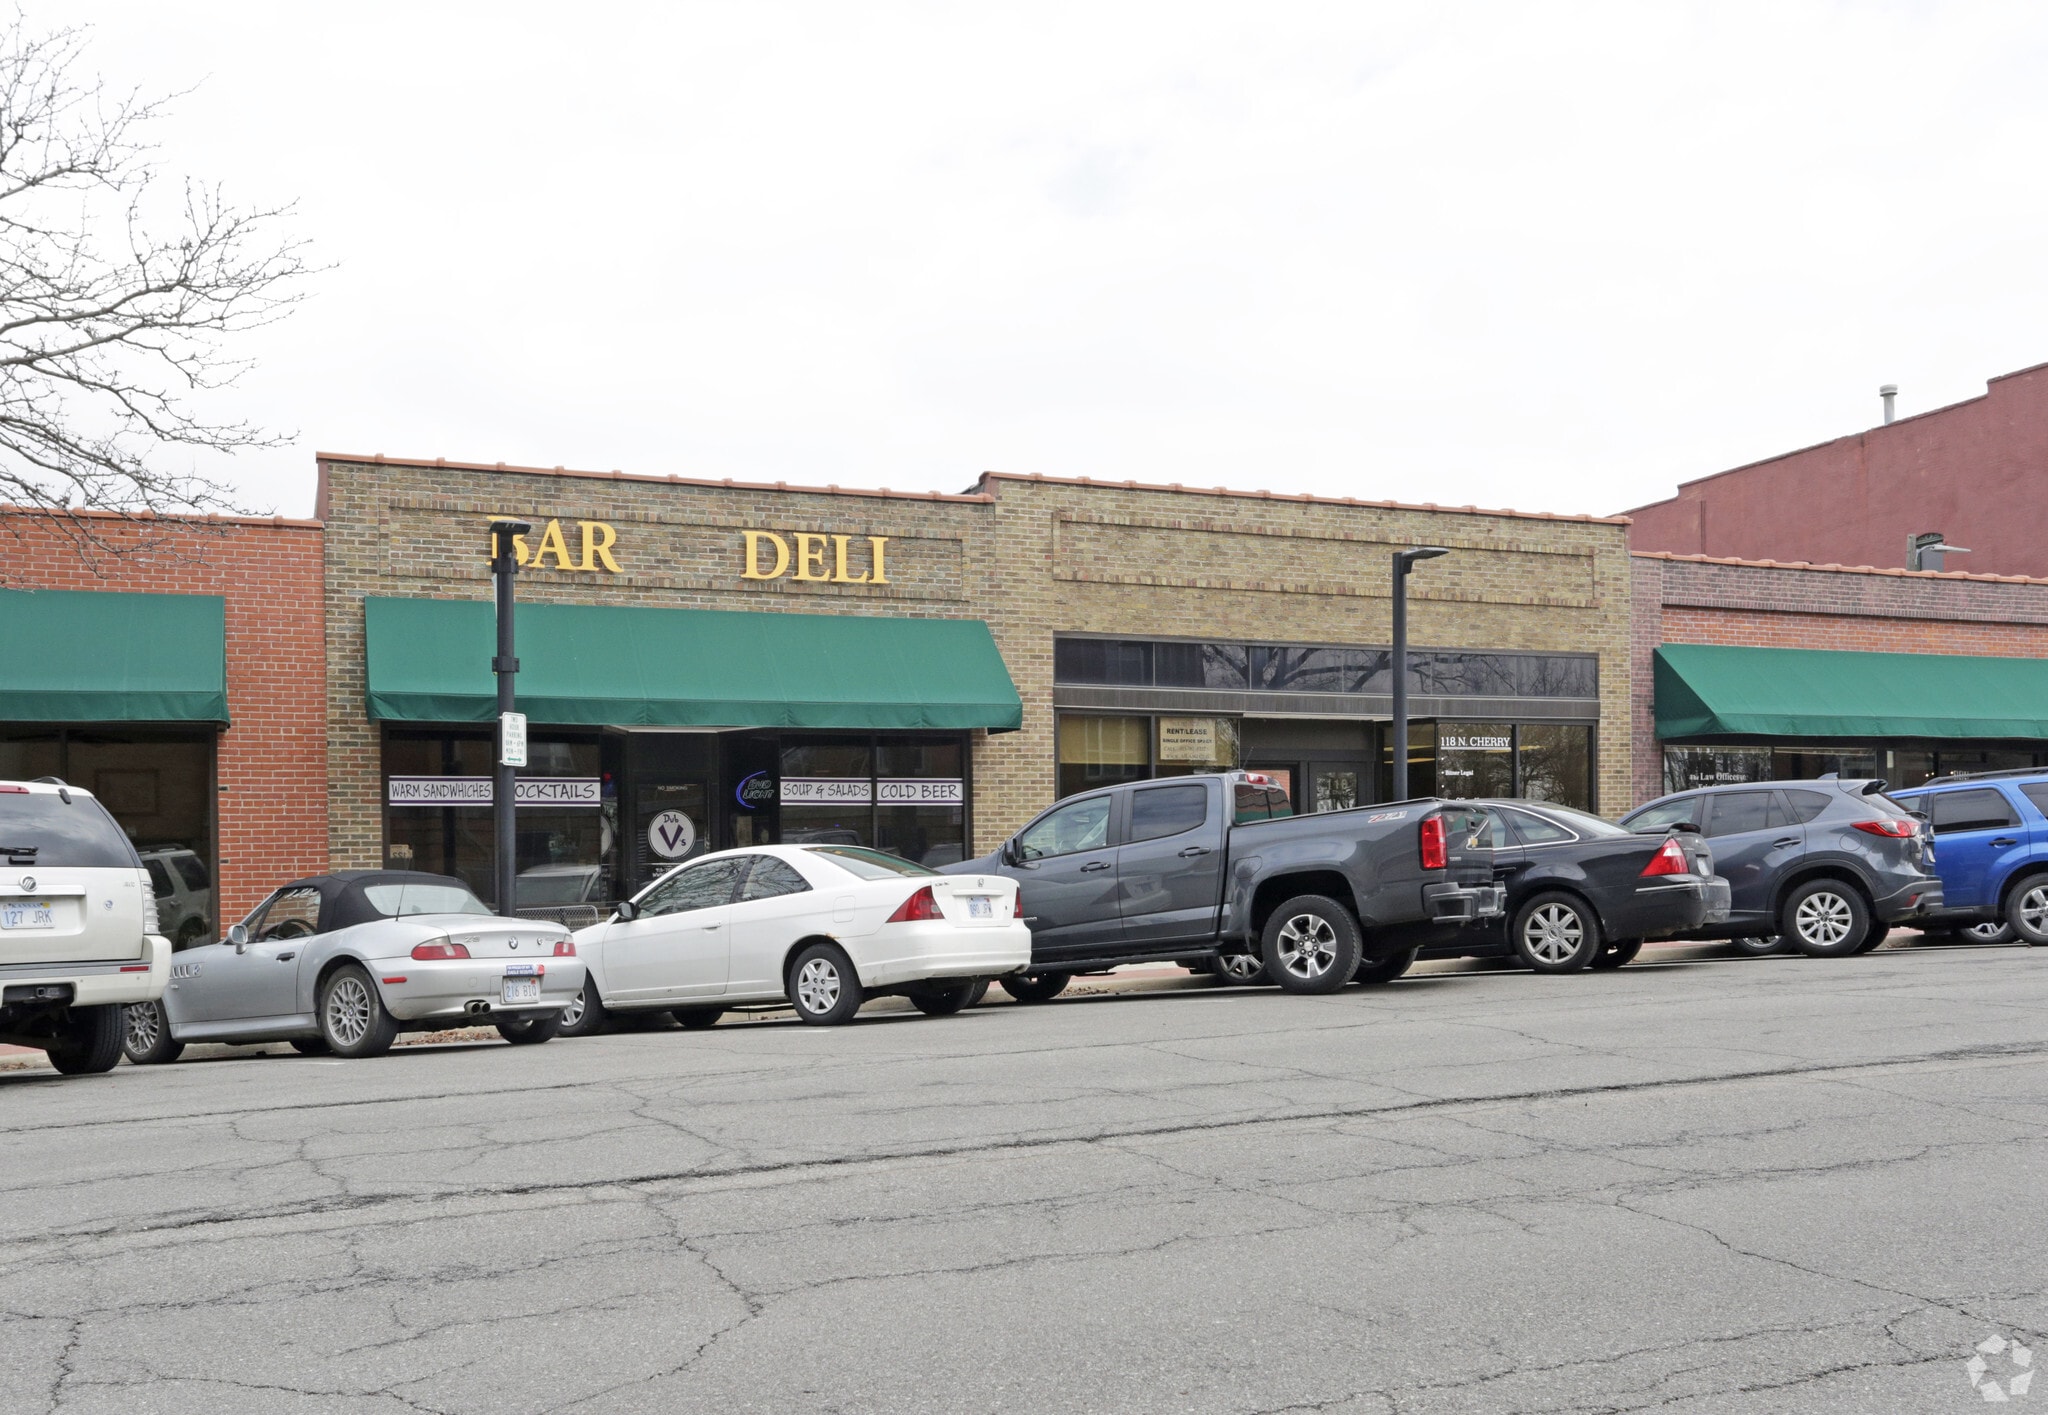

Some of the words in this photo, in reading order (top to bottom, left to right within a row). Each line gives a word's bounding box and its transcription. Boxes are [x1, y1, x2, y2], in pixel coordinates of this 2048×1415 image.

[740, 530, 890, 584] DELI
[1440, 736, 1456, 747] 118
[1458, 736, 1468, 747] N.
[1469, 736, 1511, 747] CHERRY
[1700, 772, 1714, 781] Law
[391, 783, 420, 798] WARM
[423, 783, 491, 798] SANDWHICHES
[515, 784, 595, 799] OCKTAILS
[783, 783, 813, 796] SOUP
[815, 784, 825, 798] &
[827, 783, 870, 797] SALADS
[880, 784, 917, 799] COLD
[921, 784, 960, 799] BEER
[663, 814, 679, 824] Dub
[4, 910, 24, 925] 127
[32, 910, 53, 924] JRK
[506, 985, 520, 998] 216
